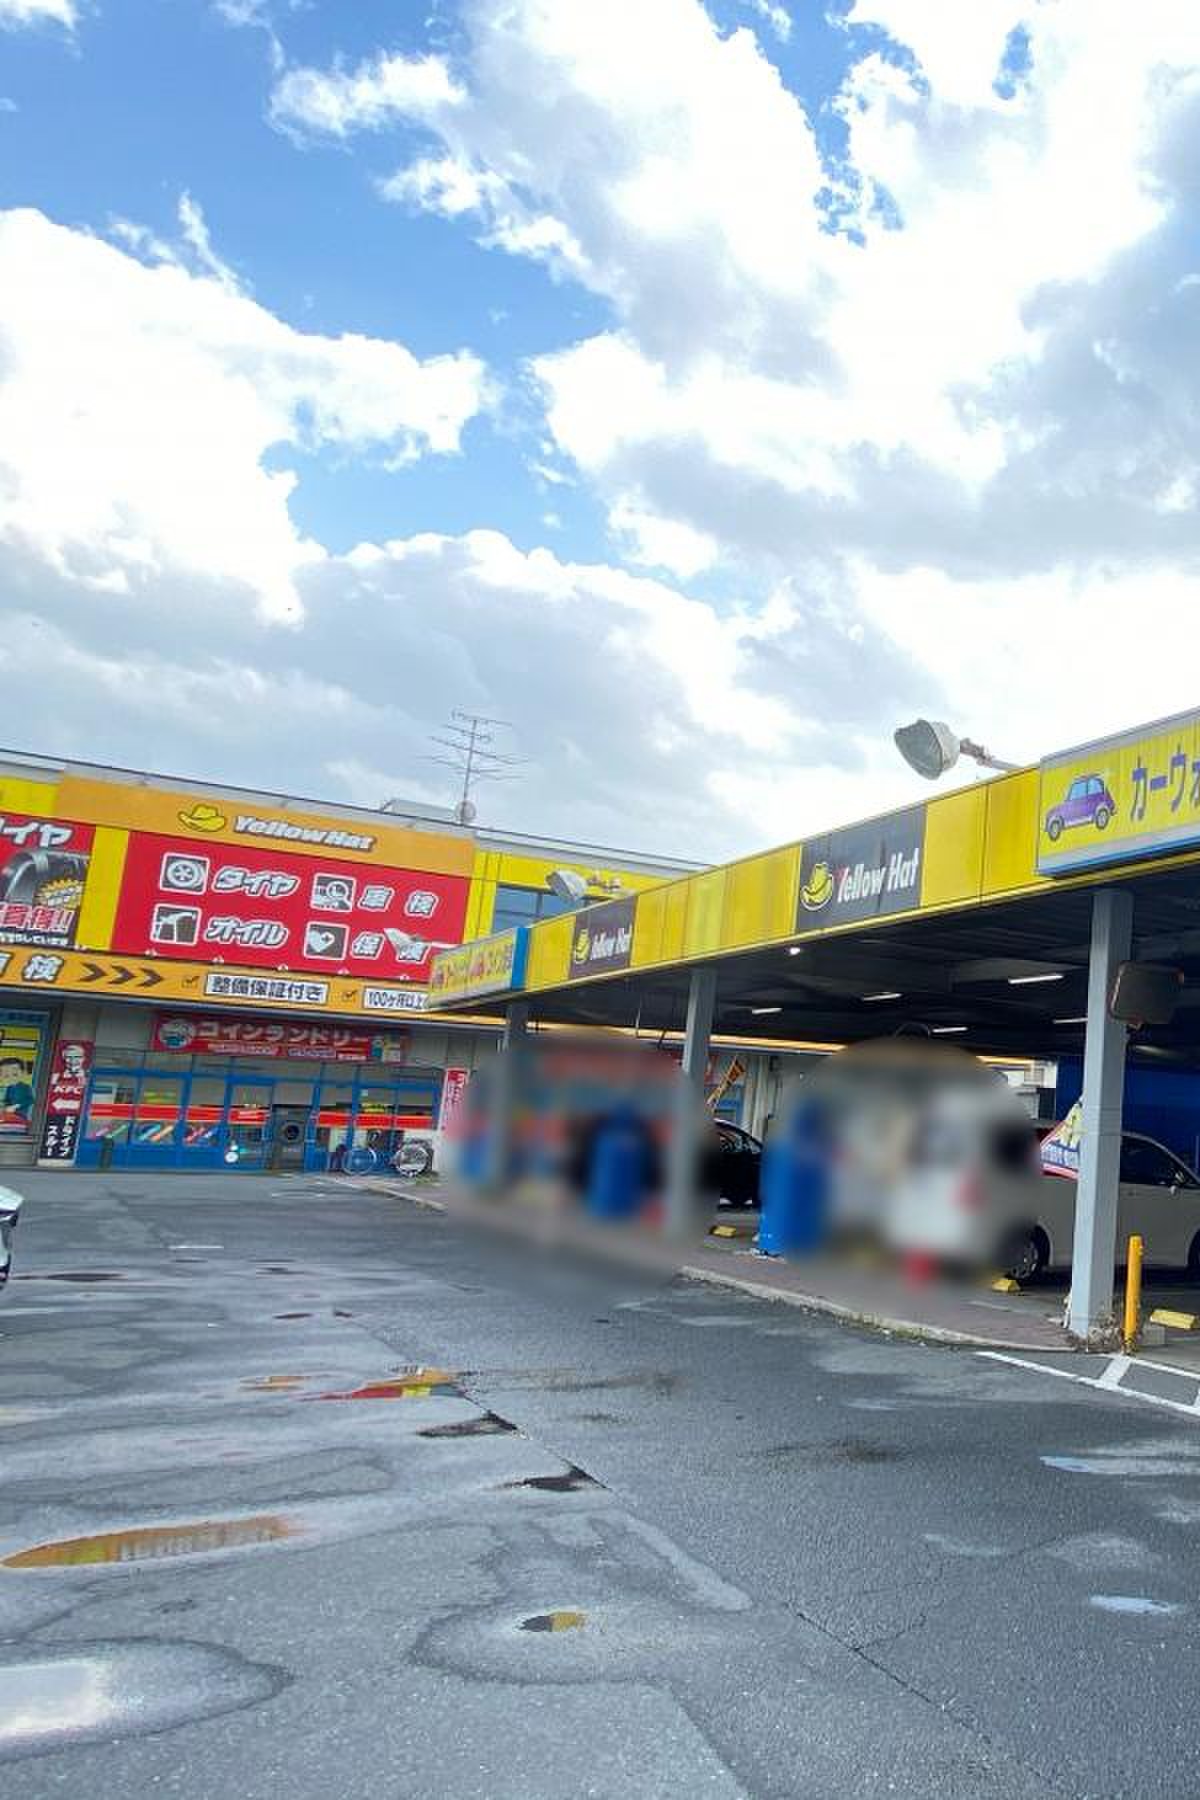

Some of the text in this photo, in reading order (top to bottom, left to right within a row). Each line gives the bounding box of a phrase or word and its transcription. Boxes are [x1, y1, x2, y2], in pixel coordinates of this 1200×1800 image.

[0, 818, 73, 848] イヤ
[235, 816, 374, 850] Yellow Hat
[213, 866, 299, 897] タイヤ
[834, 848, 920, 903] Yellow Hat
[205, 916, 289, 946] オイル
[212, 975, 322, 1001] 整備保証付き
[200, 1021, 369, 1047] コインランドリー
